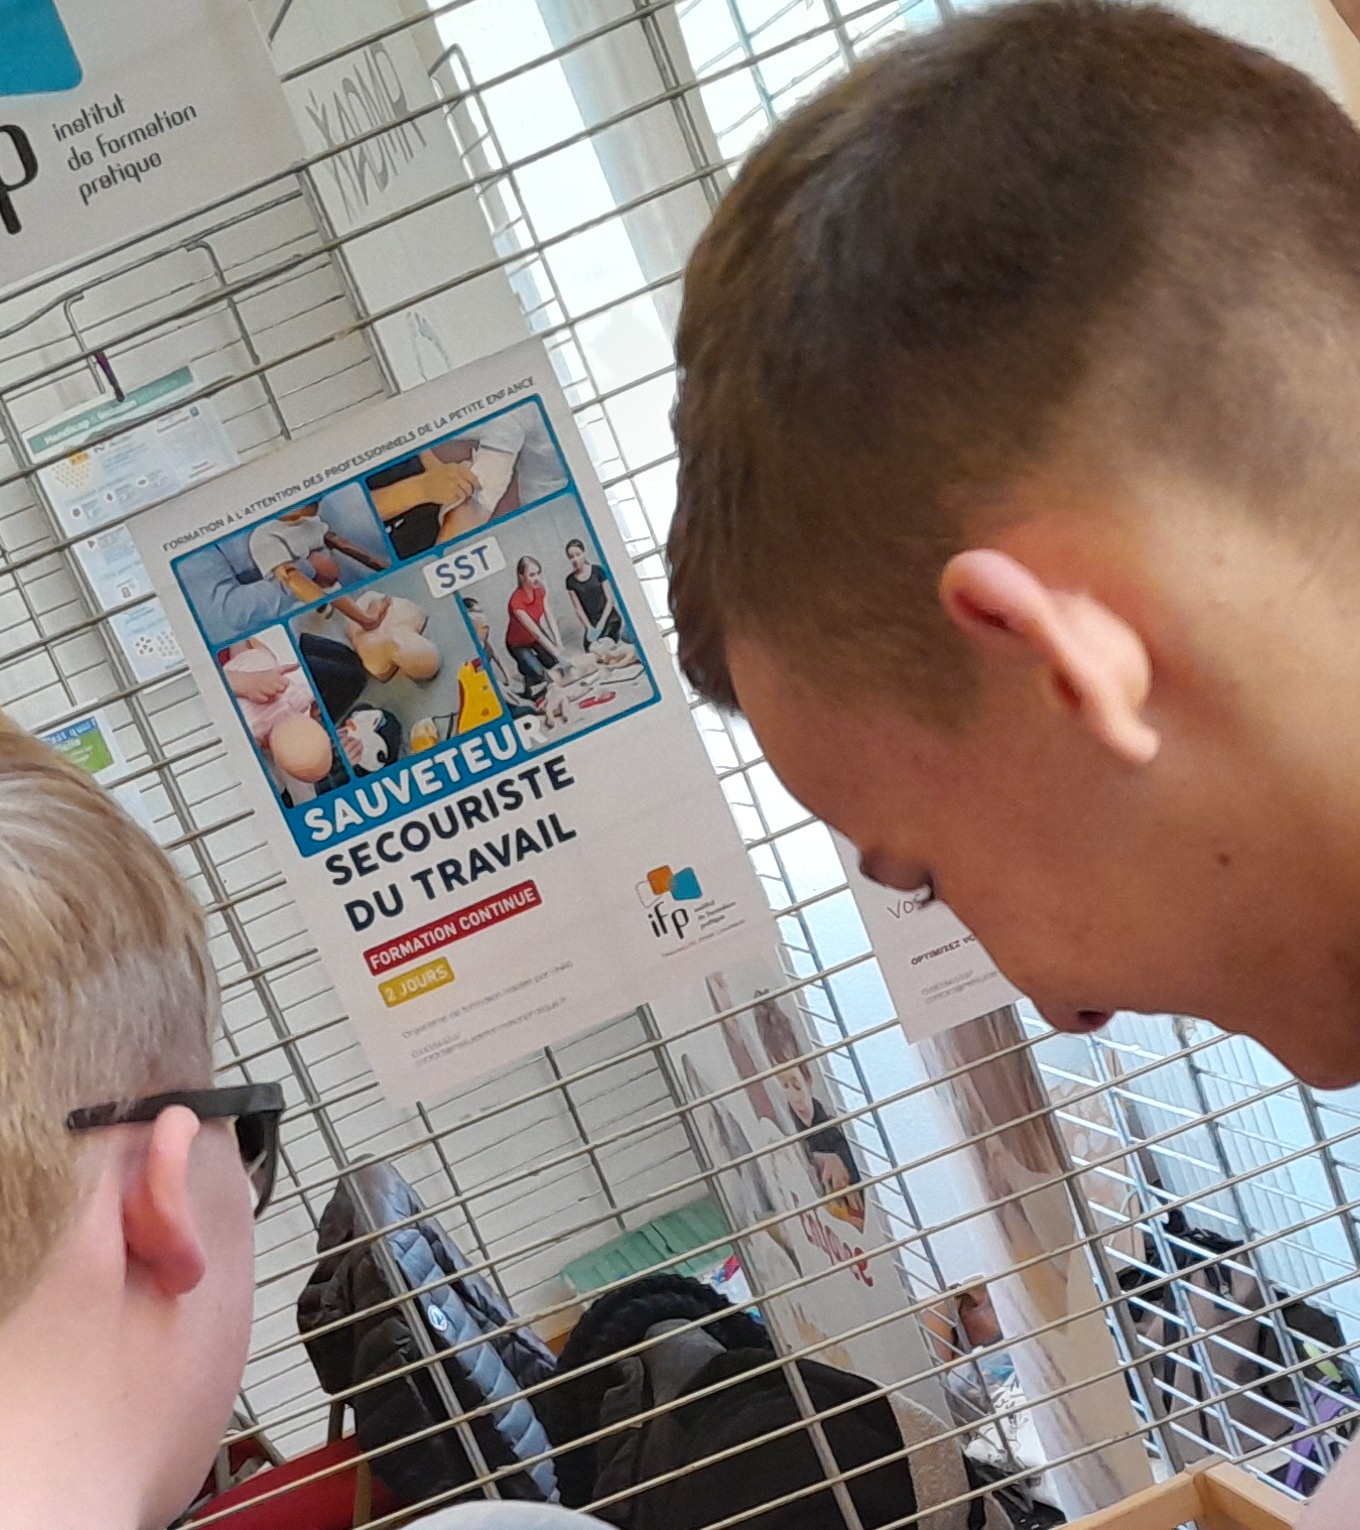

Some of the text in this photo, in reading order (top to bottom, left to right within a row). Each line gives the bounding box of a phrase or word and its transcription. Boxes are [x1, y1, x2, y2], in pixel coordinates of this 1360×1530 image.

[52, 93, 126, 142] institut
[67, 105, 198, 171] de formation
[78, 152, 163, 206] pratique
[163, 519, 226, 552] FORMATION
[235, 484, 302, 522] L'ATTENTION
[302, 473, 324, 490] DES
[325, 430, 416, 479] PROFESSIONNELS
[417, 424, 432, 437] DE
[433, 418, 448, 430] LA
[449, 400, 485, 421] PETITE
[485, 376, 535, 405] ENFANCE
[436, 546, 494, 589] SST
[303, 717, 547, 842] SAUVETEUR
[325, 755, 575, 885] SECOURISTE
[344, 812, 577, 931] DU TRAVAIL
[369, 887, 538, 971] FORMATION CONTINUE
[648, 901, 689, 940] ifp
[384, 965, 449, 1002] 2 JOURS
